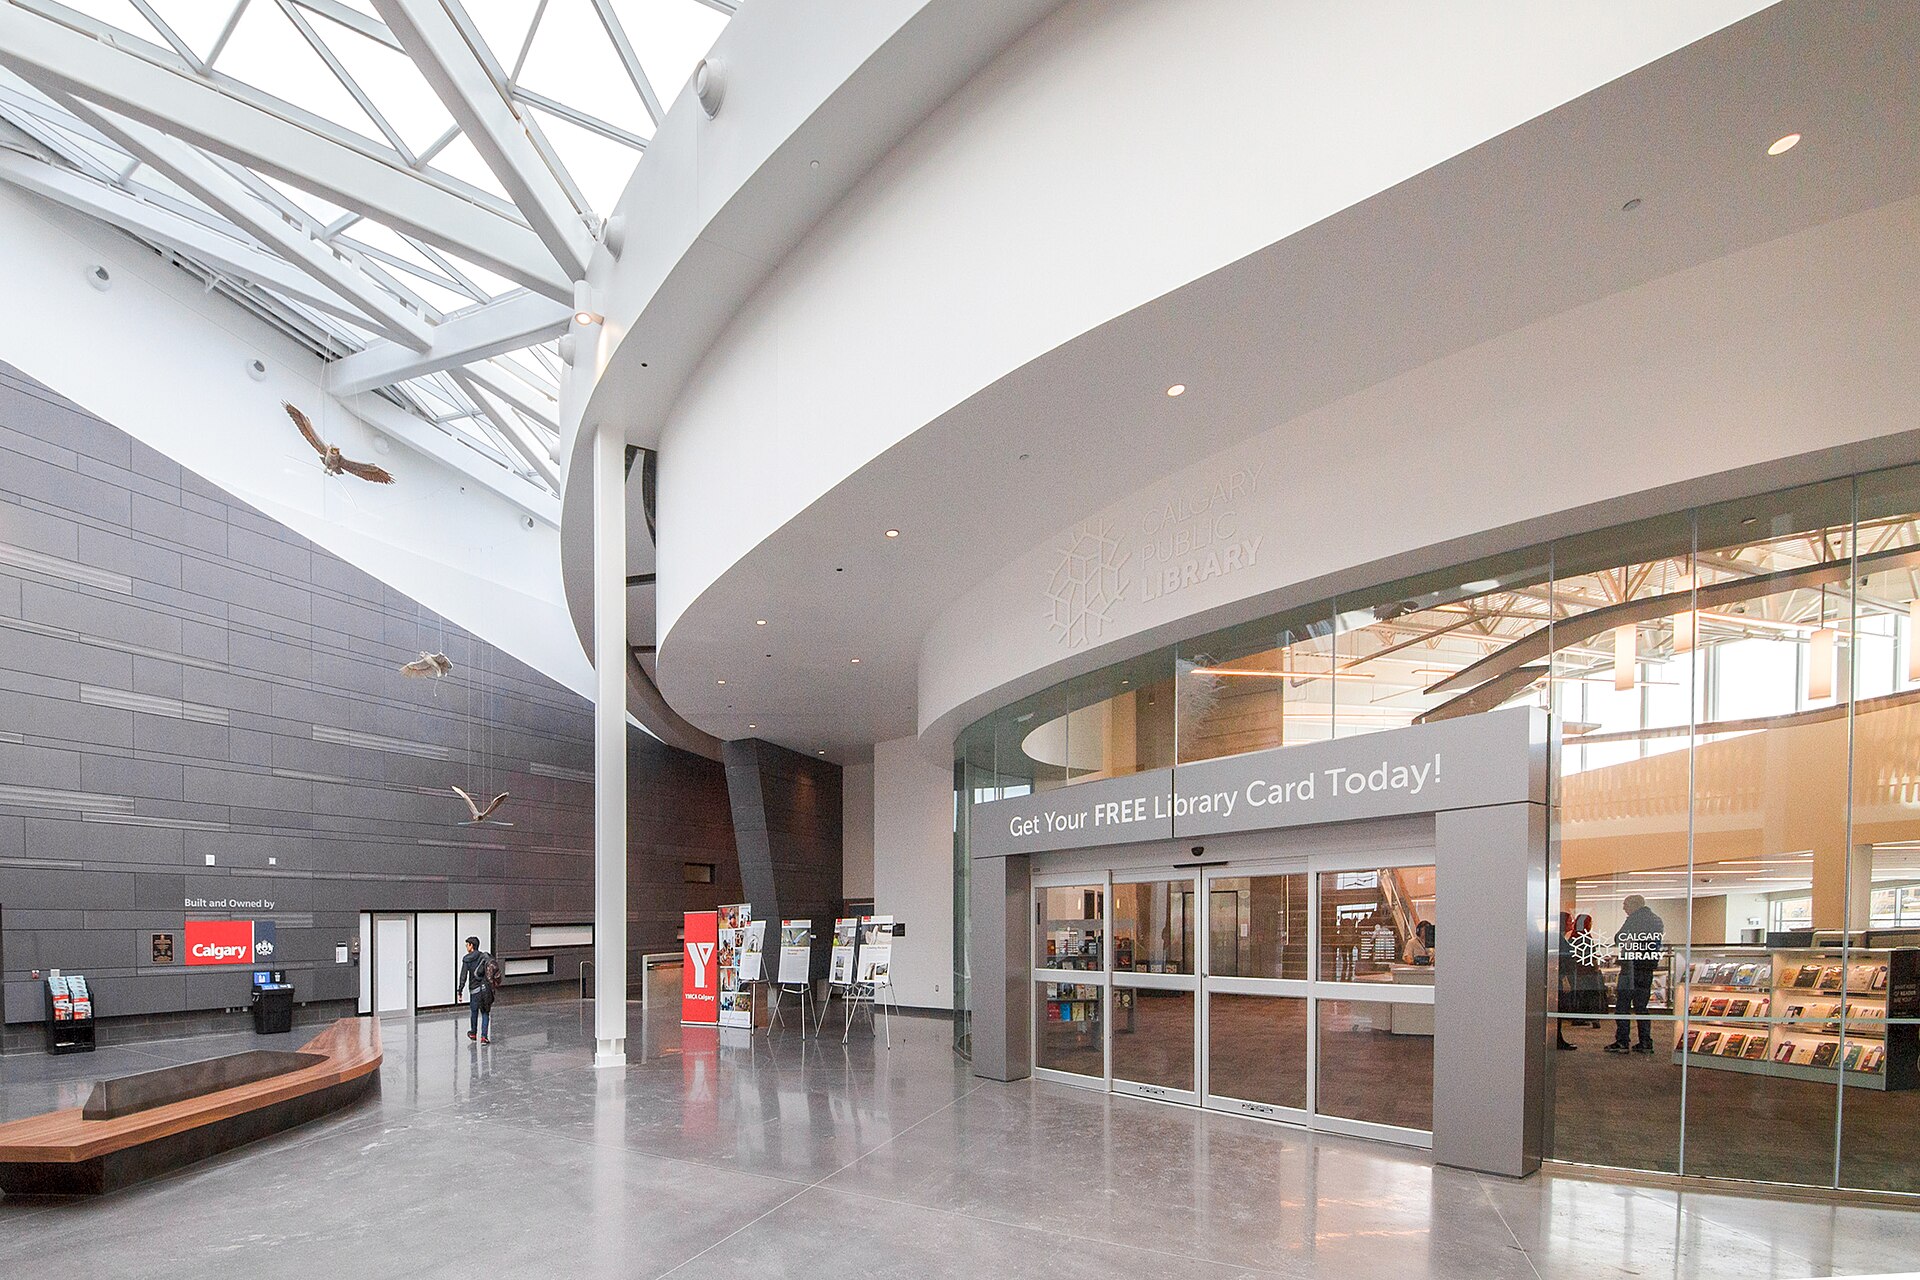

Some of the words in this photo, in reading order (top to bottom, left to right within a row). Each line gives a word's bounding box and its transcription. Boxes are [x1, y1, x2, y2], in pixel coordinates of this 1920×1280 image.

[1142, 462, 1265, 535] CALGARY
[1141, 511, 1237, 570] PUBLIC
[1141, 533, 1264, 603] LIBRARY
[1009, 816, 1040, 837] Get
[1045, 809, 1087, 833] Your
[1094, 797, 1147, 827] FREE
[1154, 788, 1238, 818] Library
[1246, 773, 1315, 807] Card
[1325, 754, 1442, 796] Today!
[184, 898, 206, 908] Built
[208, 898, 227, 908] and
[229, 899, 262, 908] Owned
[264, 899, 275, 909] by
[1618, 932, 1666, 941] CALGARY
[192, 943, 247, 960] Calgary
[1618, 942, 1656, 951] PUBLIC
[1618, 952, 1666, 960] LIBRARY
[698, 993, 715, 1001] Calgary
